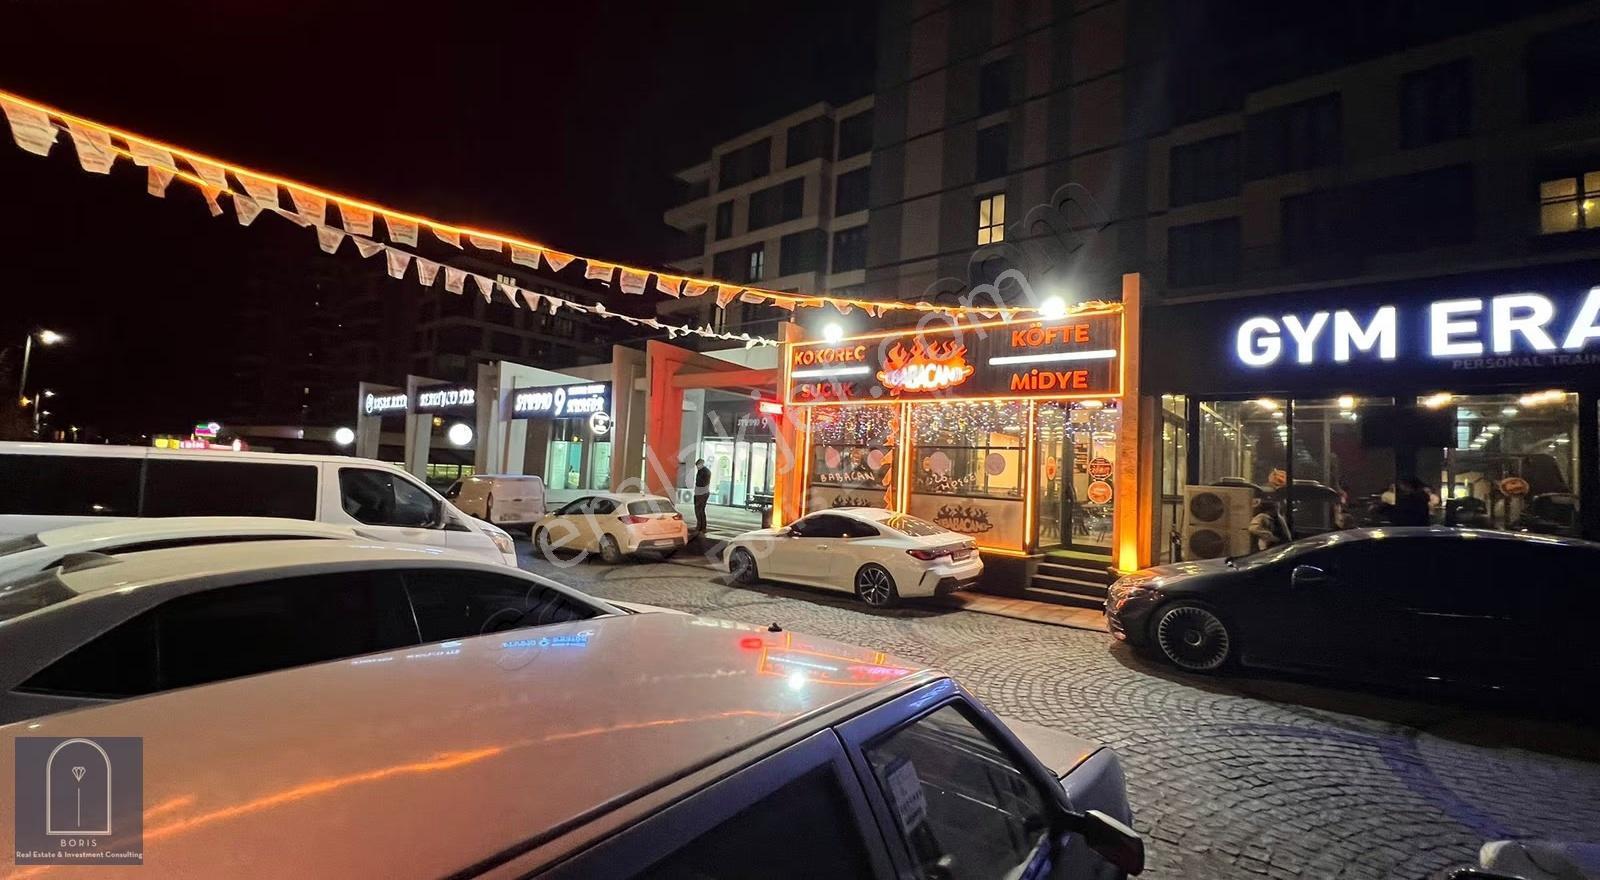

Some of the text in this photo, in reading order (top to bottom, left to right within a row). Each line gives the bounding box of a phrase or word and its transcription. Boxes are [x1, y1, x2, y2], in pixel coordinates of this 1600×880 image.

[1011, 322, 1090, 347] KÖFTE
[1237, 305, 1397, 367] GYM
[794, 345, 866, 366] KOKOREÇ
[1452, 356, 1544, 370] PERSONAL
[554, 387, 567, 416] 9
[820, 470, 875, 482] BABACAN
